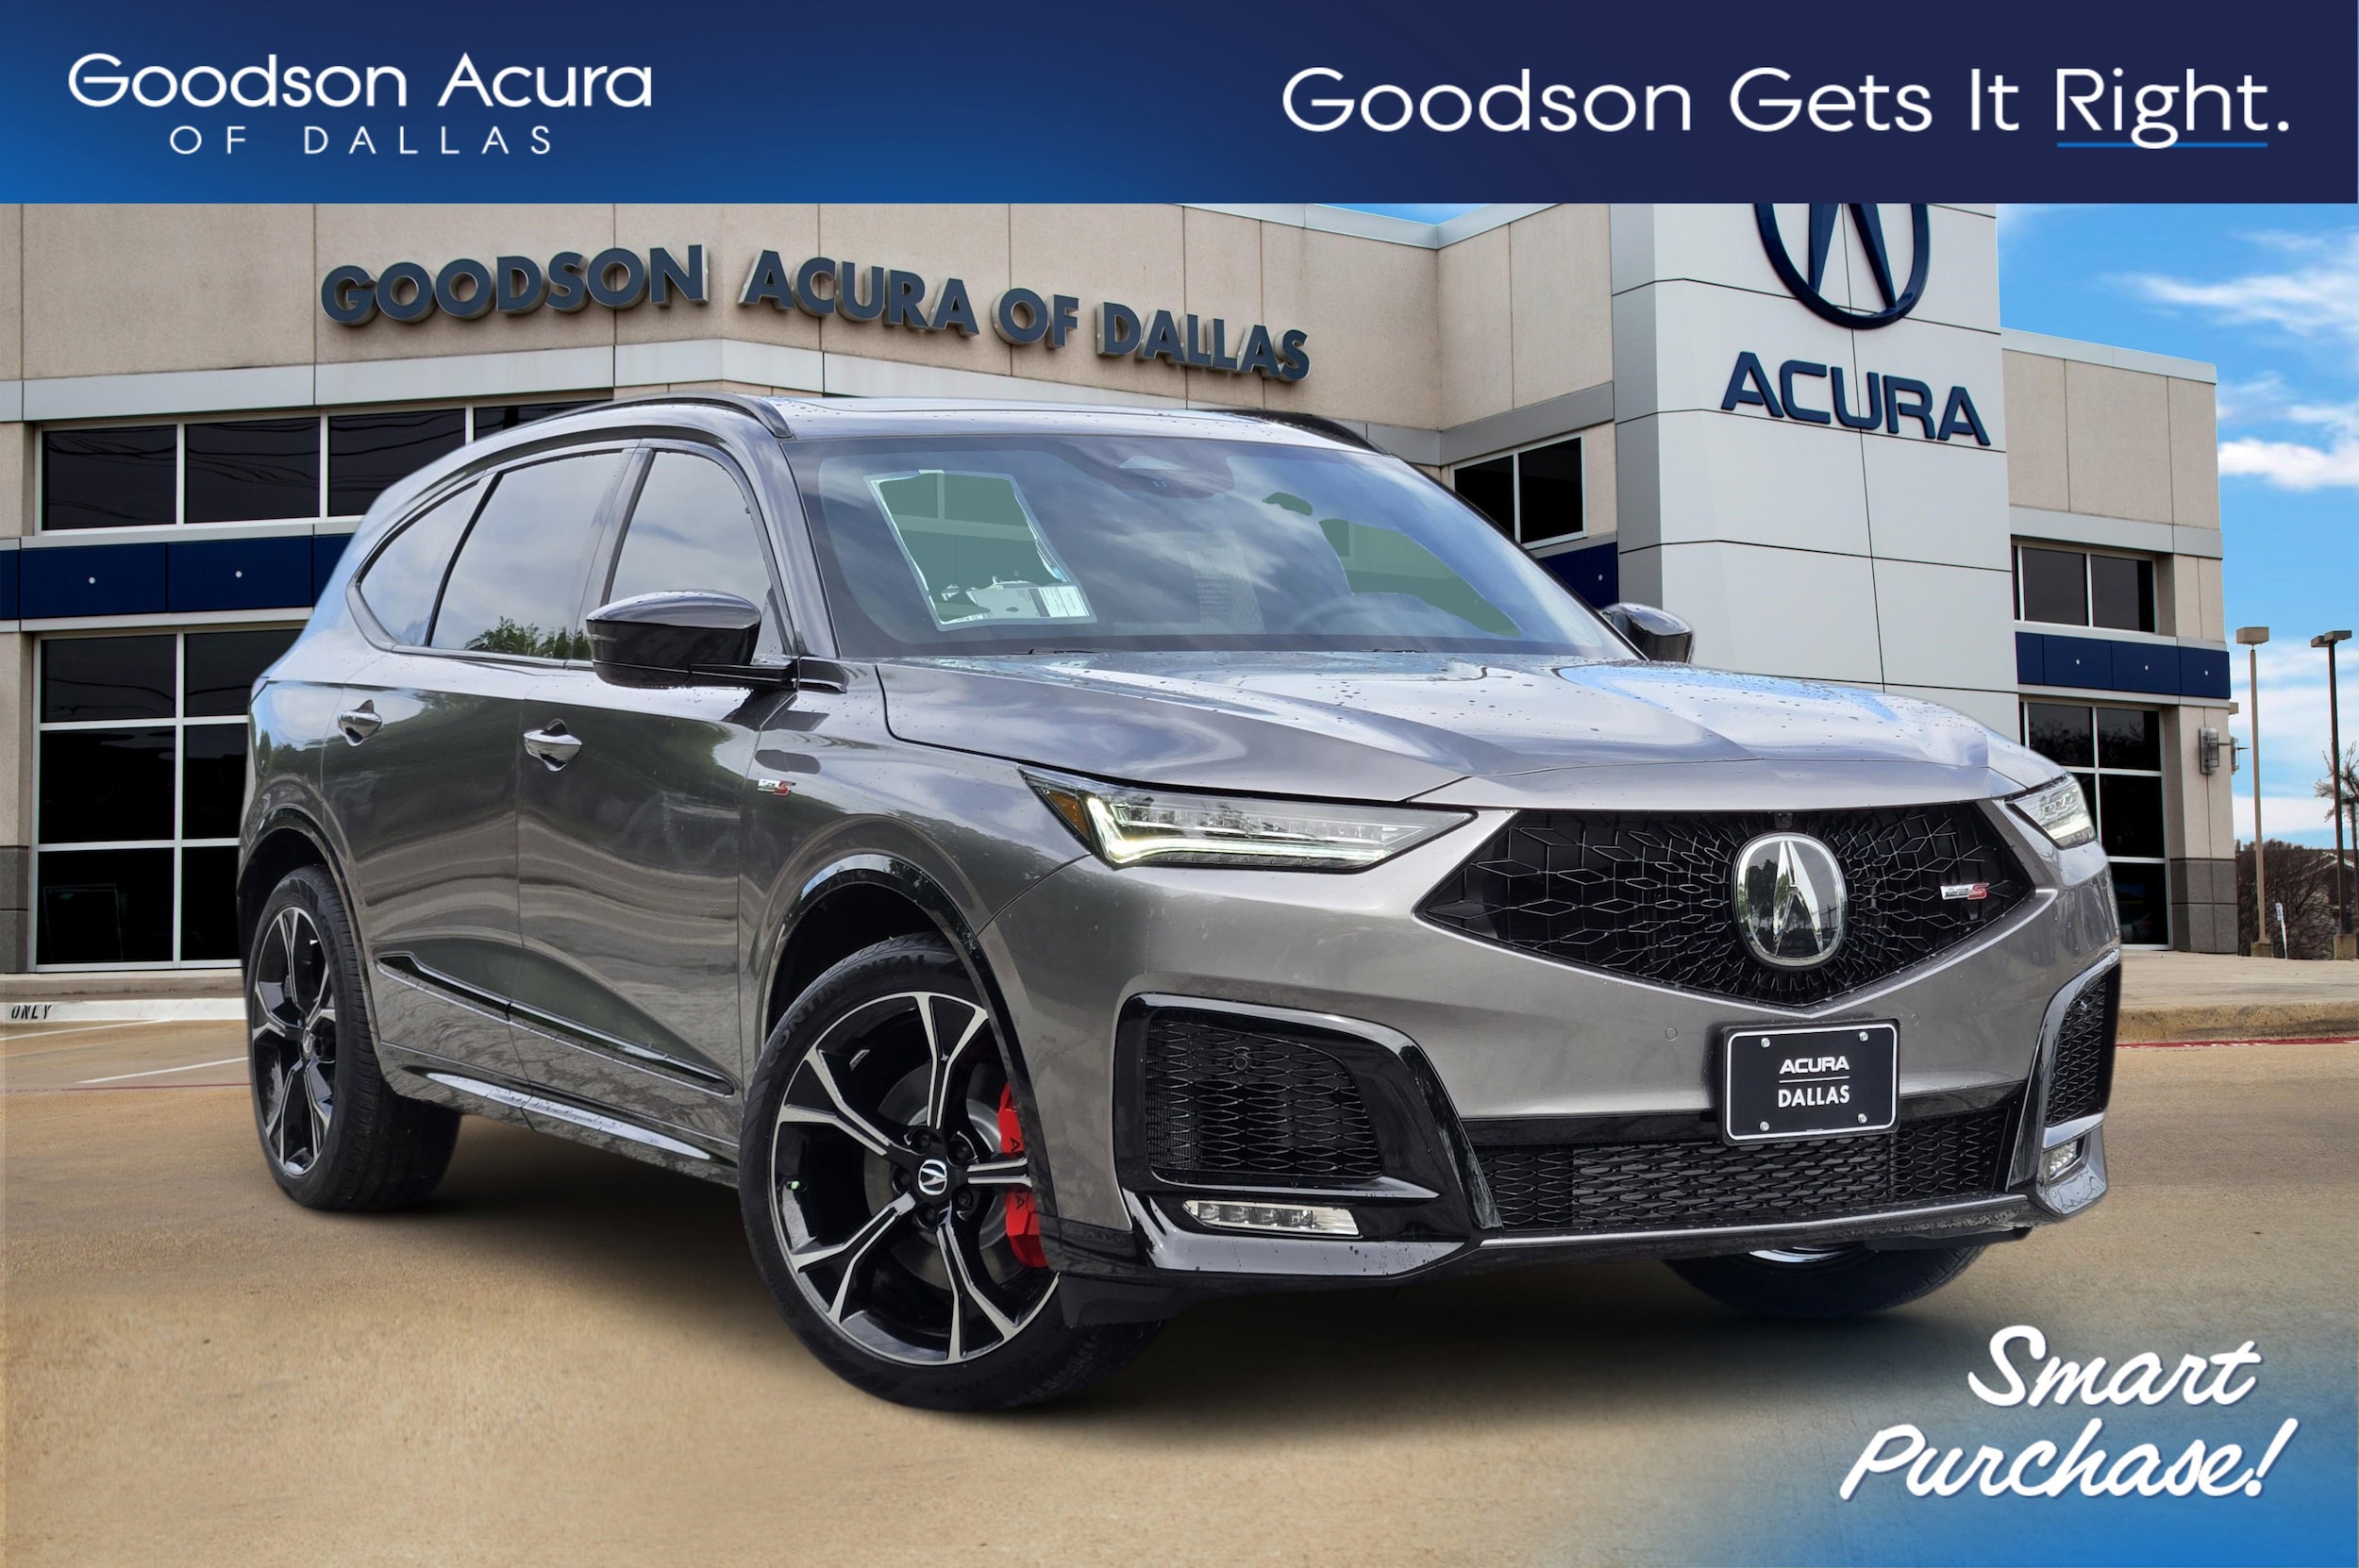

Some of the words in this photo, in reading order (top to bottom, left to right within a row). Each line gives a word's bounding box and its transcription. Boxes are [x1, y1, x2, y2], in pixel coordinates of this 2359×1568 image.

[321, 243, 709, 326] GOODSON
[739, 249, 979, 337] ACURA
[992, 287, 1079, 349] OF
[1096, 301, 1311, 382] DALLAS
[1720, 351, 1991, 446] ACURA
[10, 1003, 53, 1020] ONLY
[1779, 1055, 1850, 1075] ACURA
[1778, 1084, 1850, 1109] DALLAS
